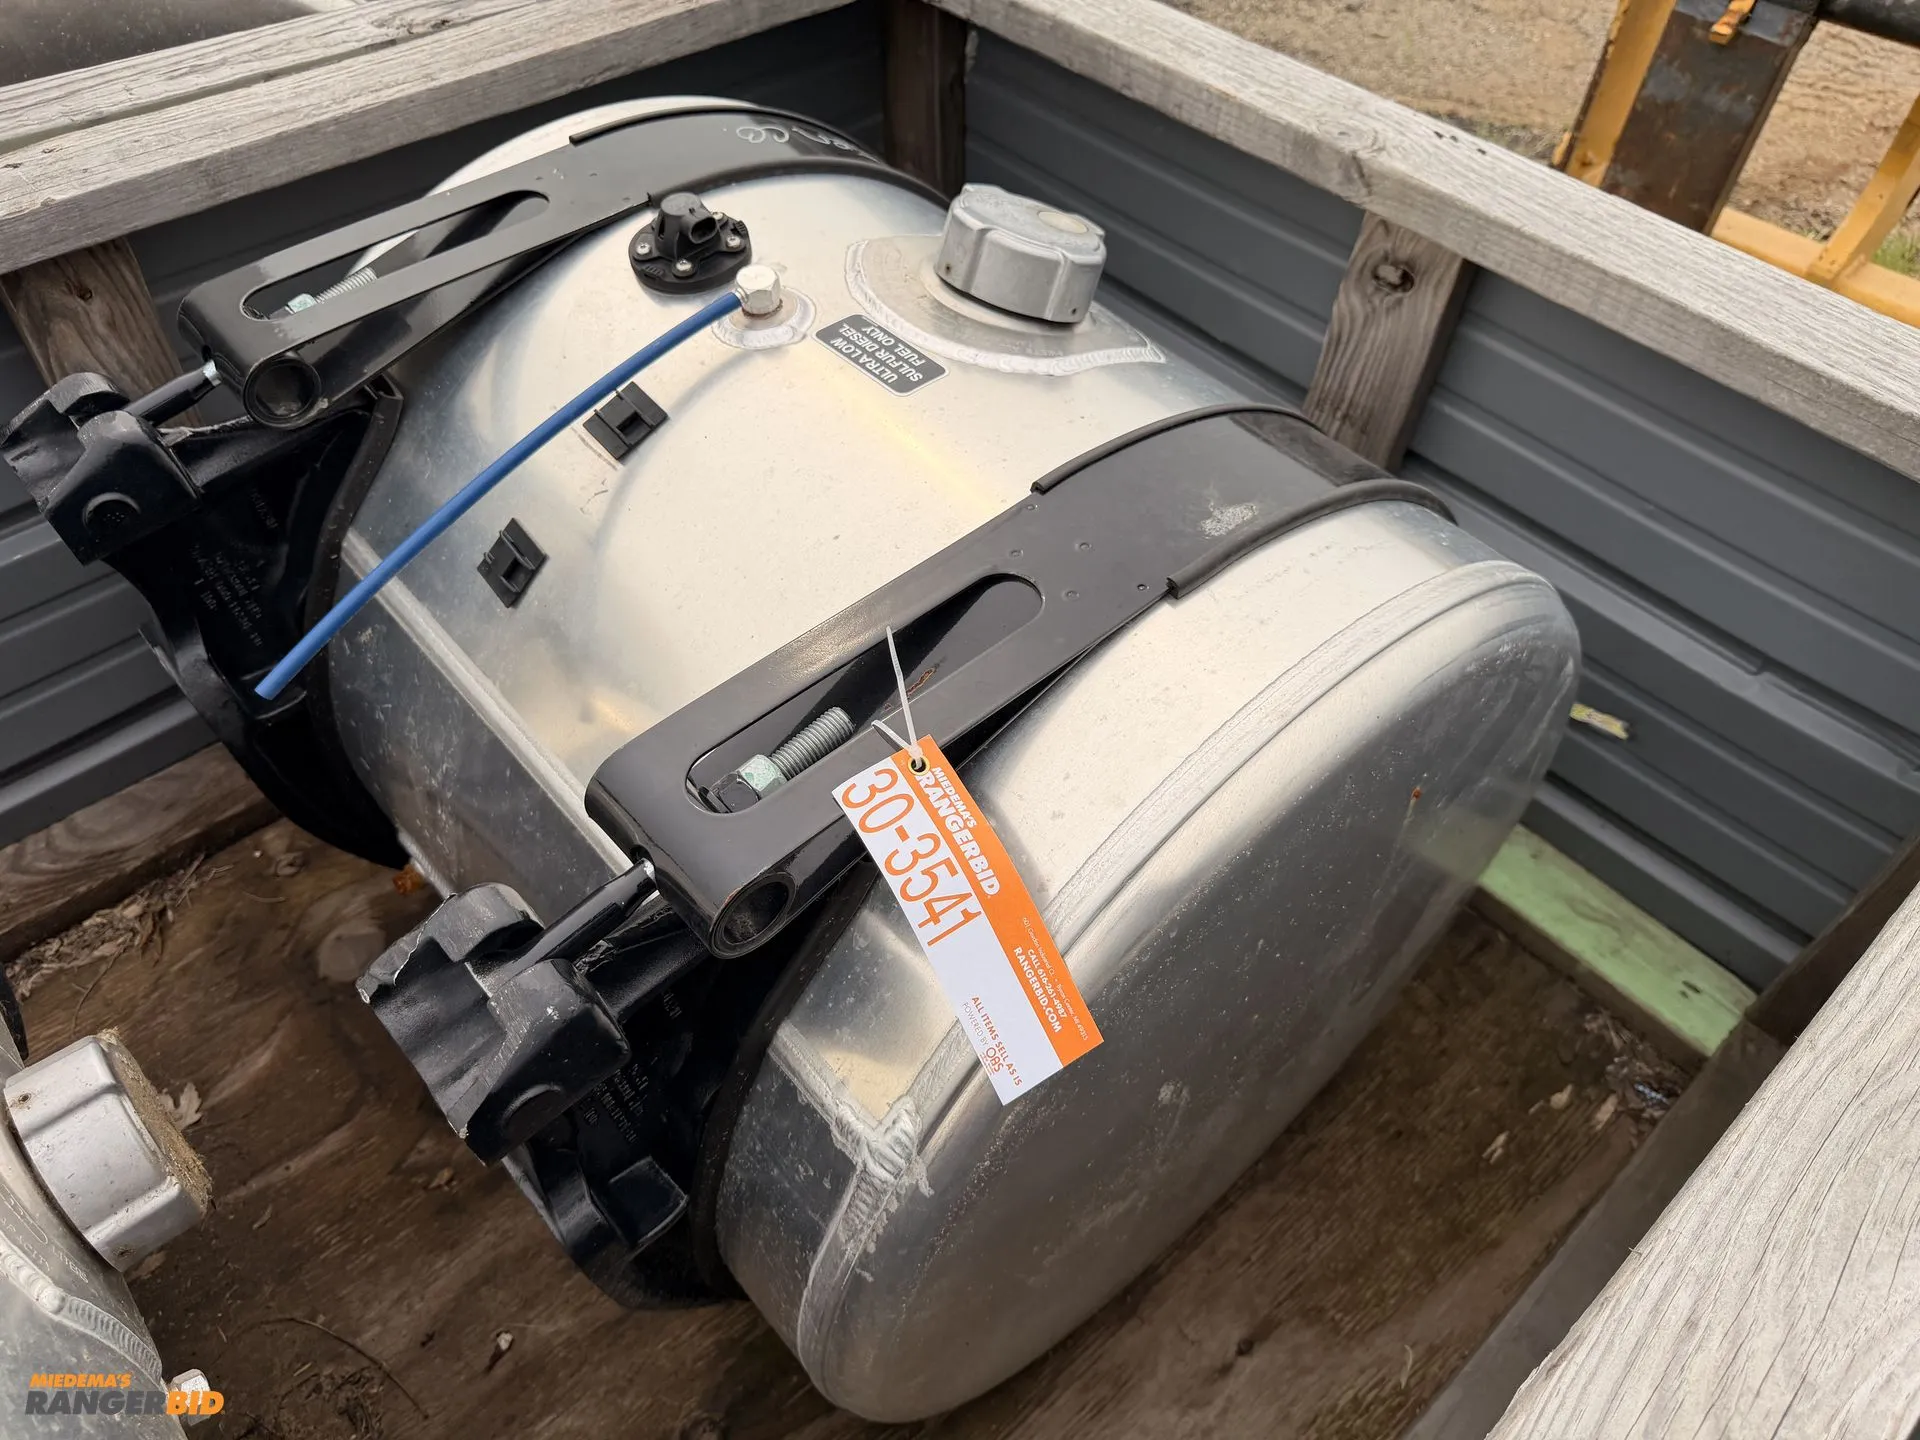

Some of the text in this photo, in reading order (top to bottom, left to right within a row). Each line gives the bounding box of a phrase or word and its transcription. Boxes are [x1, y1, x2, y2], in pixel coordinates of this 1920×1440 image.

[830, 336, 896, 383] ULTRA LOW
[840, 322, 923, 381] SULFUR DIESEL
[861, 324, 925, 366] FUEL ONLY
[931, 766, 977, 828] MIEDEMA'S
[843, 766, 982, 947] 30-3541
[915, 773, 1002, 896] RANGERBID
[1014, 947, 1061, 1031] RANGERBID.COM
[1028, 949, 1067, 1018] CALL 616-261-4987
[1055, 983, 1066, 999] Byron
[1076, 1023, 1088, 1040] 49315
[962, 1002, 983, 1036] POWERED
[980, 1036, 988, 1046] BY
[984, 1046, 1004, 1072] OAS
[973, 996, 984, 1011] ALL
[981, 1013, 999, 1040] ITEMS
[994, 1041, 1009, 1061] SELL
[1006, 1061, 1016, 1075] AS
[1013, 1075, 1023, 1086] IS
